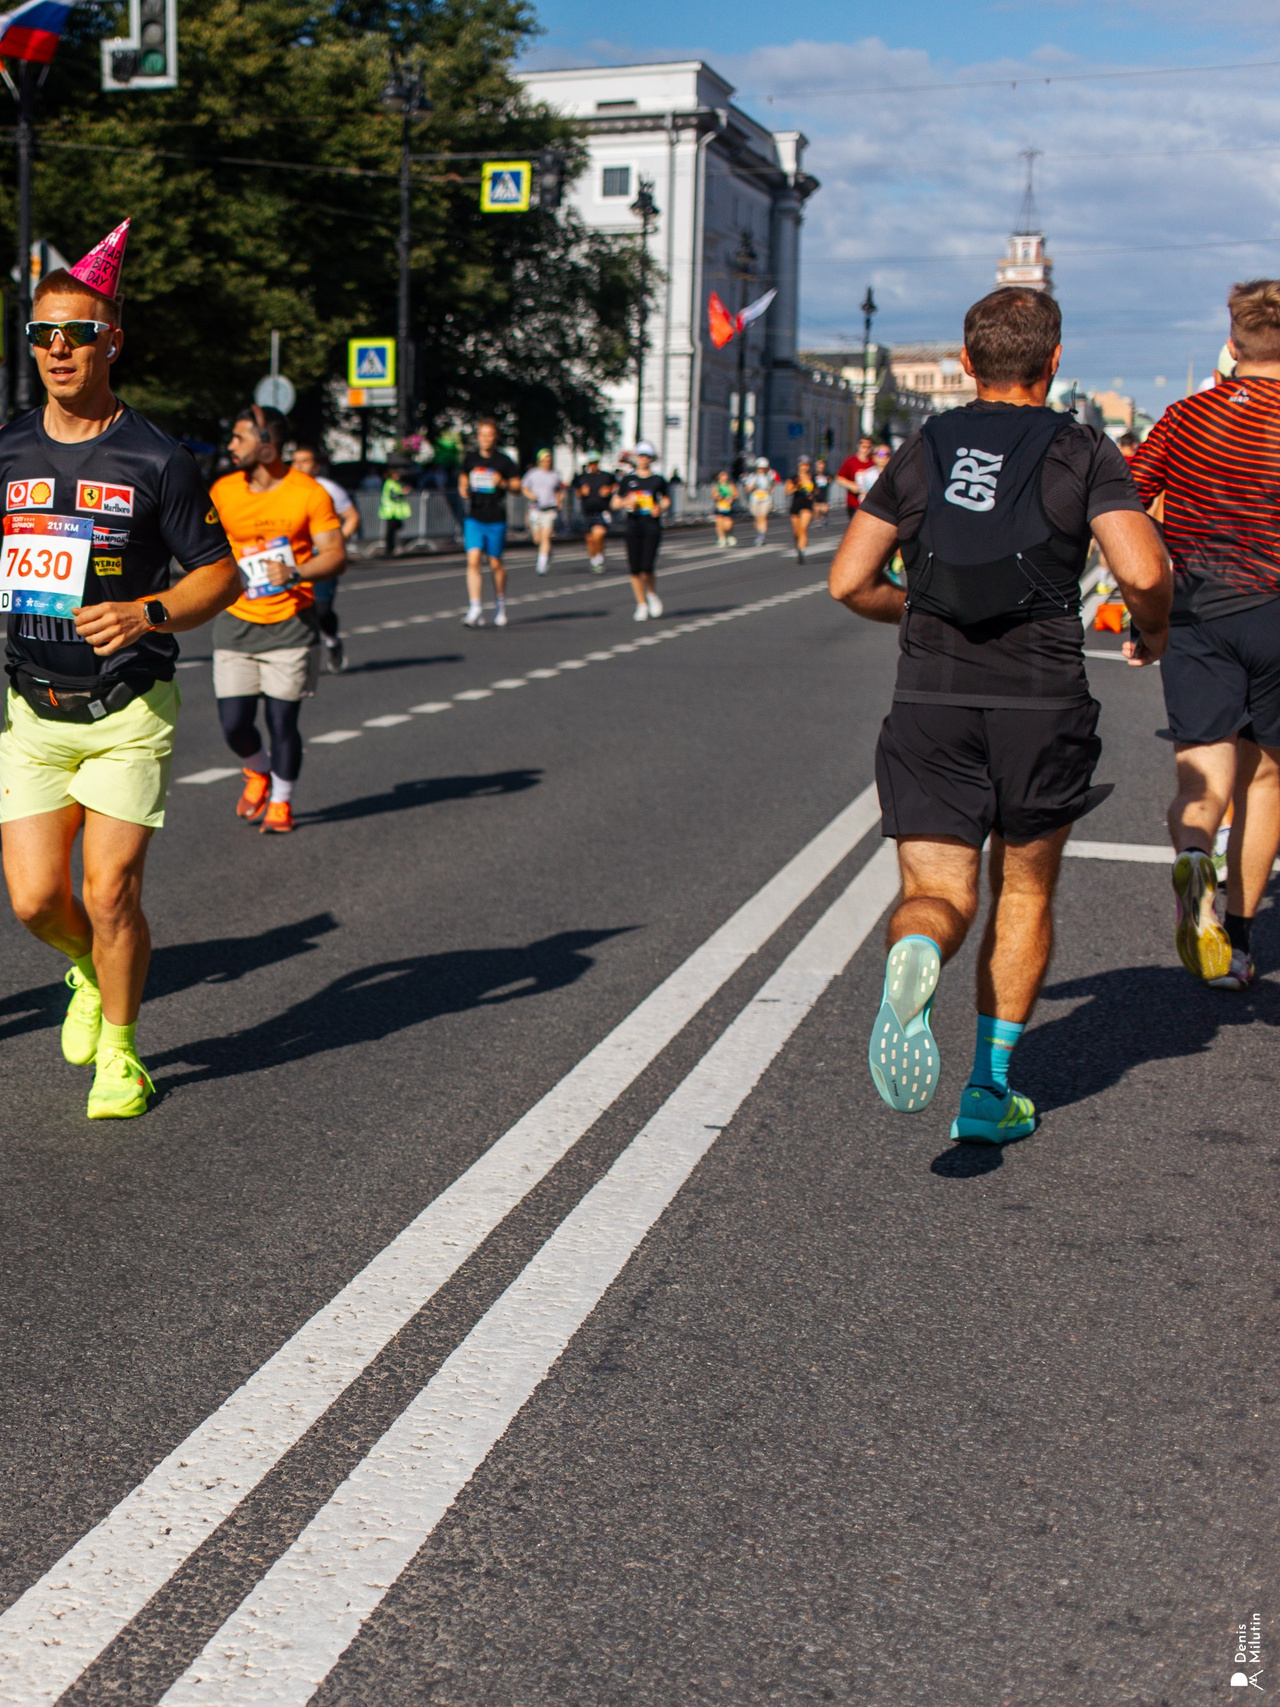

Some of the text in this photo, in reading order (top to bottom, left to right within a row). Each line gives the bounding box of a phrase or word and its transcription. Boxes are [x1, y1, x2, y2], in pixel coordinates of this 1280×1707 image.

[86, 269, 109, 288] DAY
[103, 502, 131, 514] Marlboro
[47, 521, 62, 532] 21,1
[6, 548, 73, 581] 7630
[1, 592, 9, 609] D
